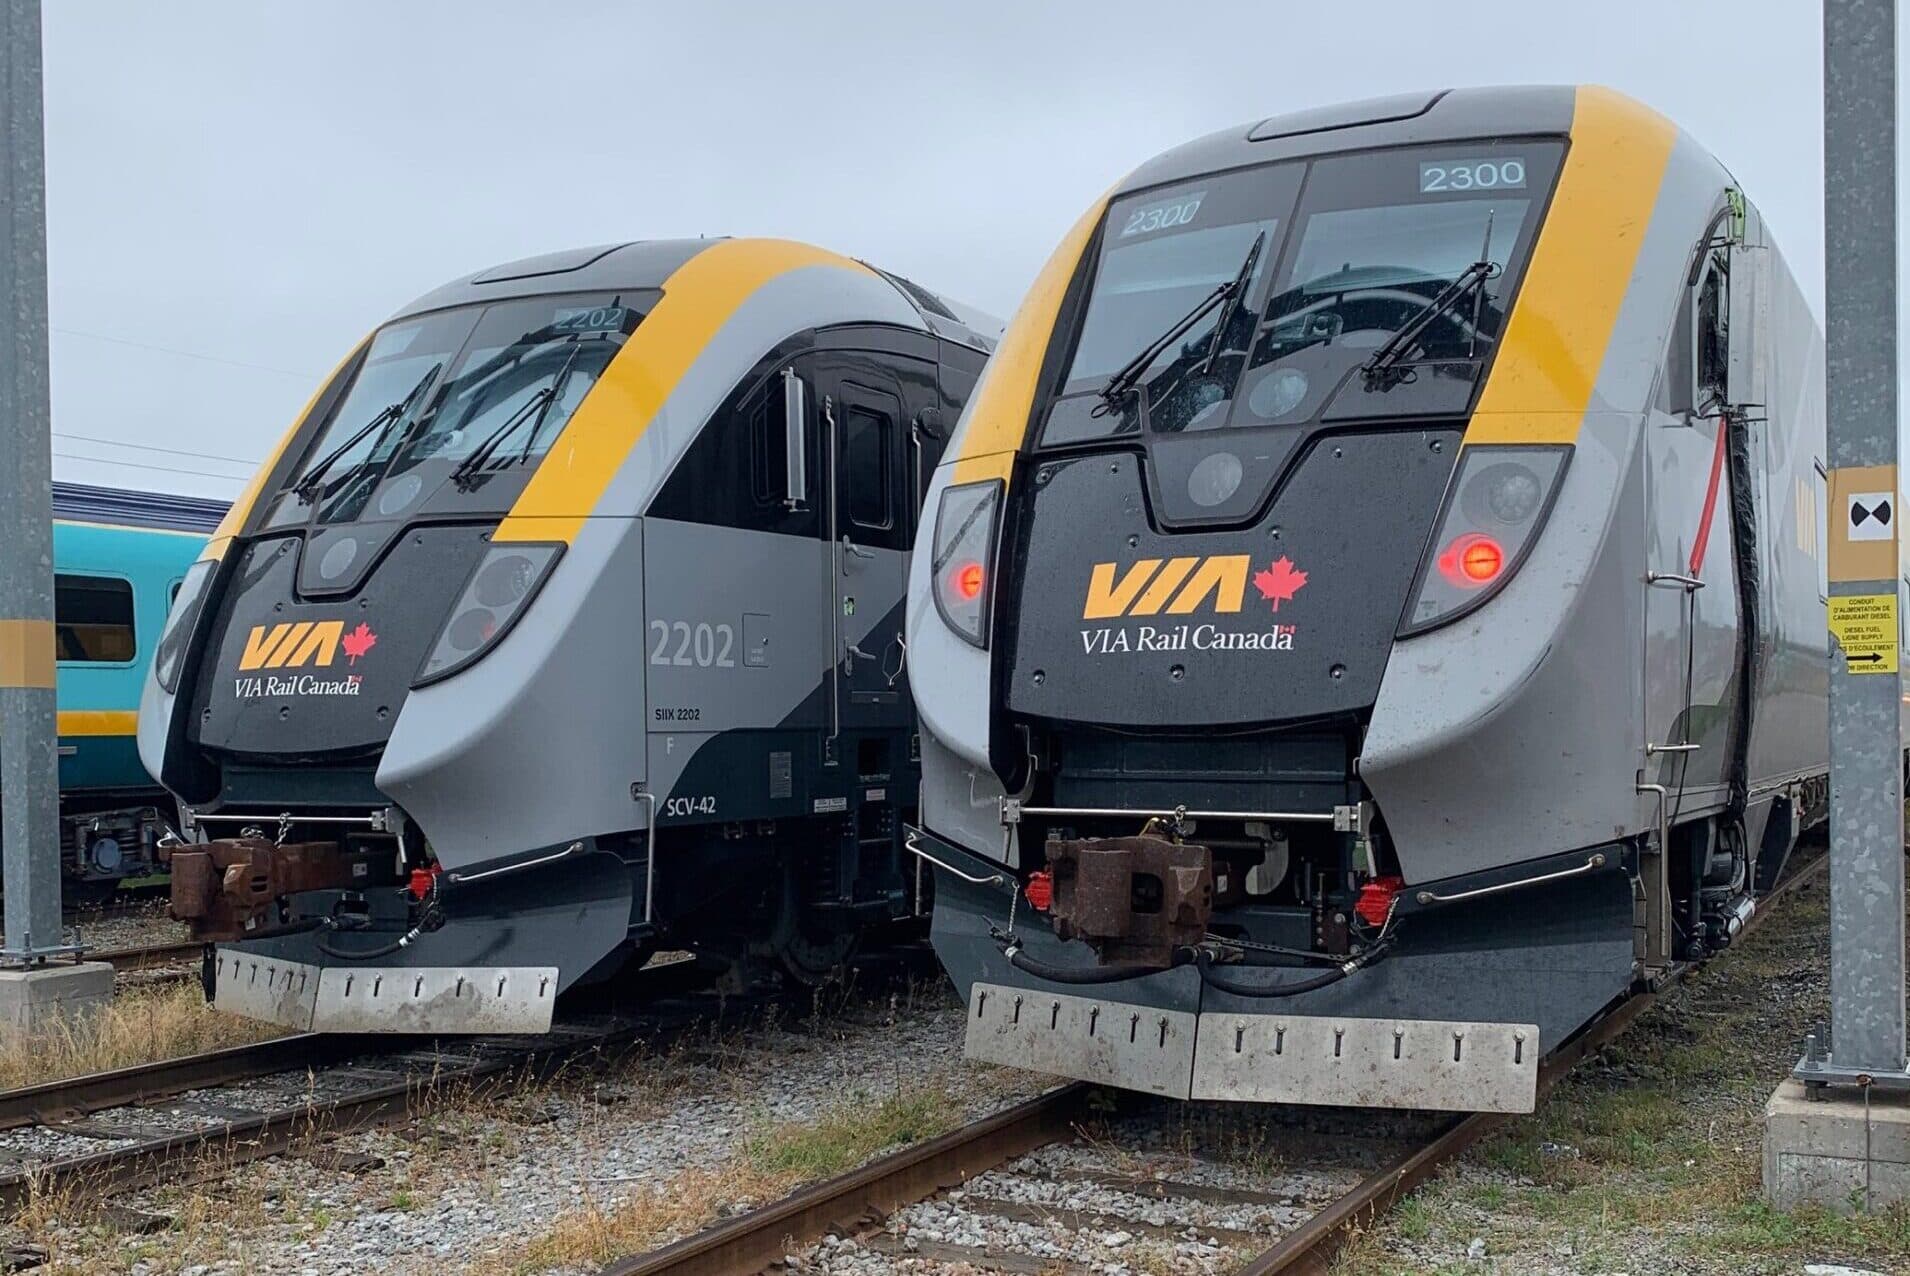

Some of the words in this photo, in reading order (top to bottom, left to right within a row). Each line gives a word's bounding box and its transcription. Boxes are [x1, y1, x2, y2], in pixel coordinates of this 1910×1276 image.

[1423, 161, 1525, 192] 2300
[1123, 200, 1201, 234] 2300
[555, 308, 622, 329] 2202
[1083, 554, 1251, 620] VIA
[238, 620, 345, 671] VIA
[650, 619, 735, 668] 2202
[1080, 628, 1131, 655] VIA
[1137, 625, 1189, 651] Rail
[1192, 624, 1294, 651] Canada
[234, 678, 263, 698] VIA
[265, 676, 298, 696] Rail
[298, 674, 360, 696] Canada
[655, 708, 675, 721] SIIX
[677, 708, 700, 721] 2202
[666, 736, 674, 754] F
[667, 796, 716, 817] SCV-42
